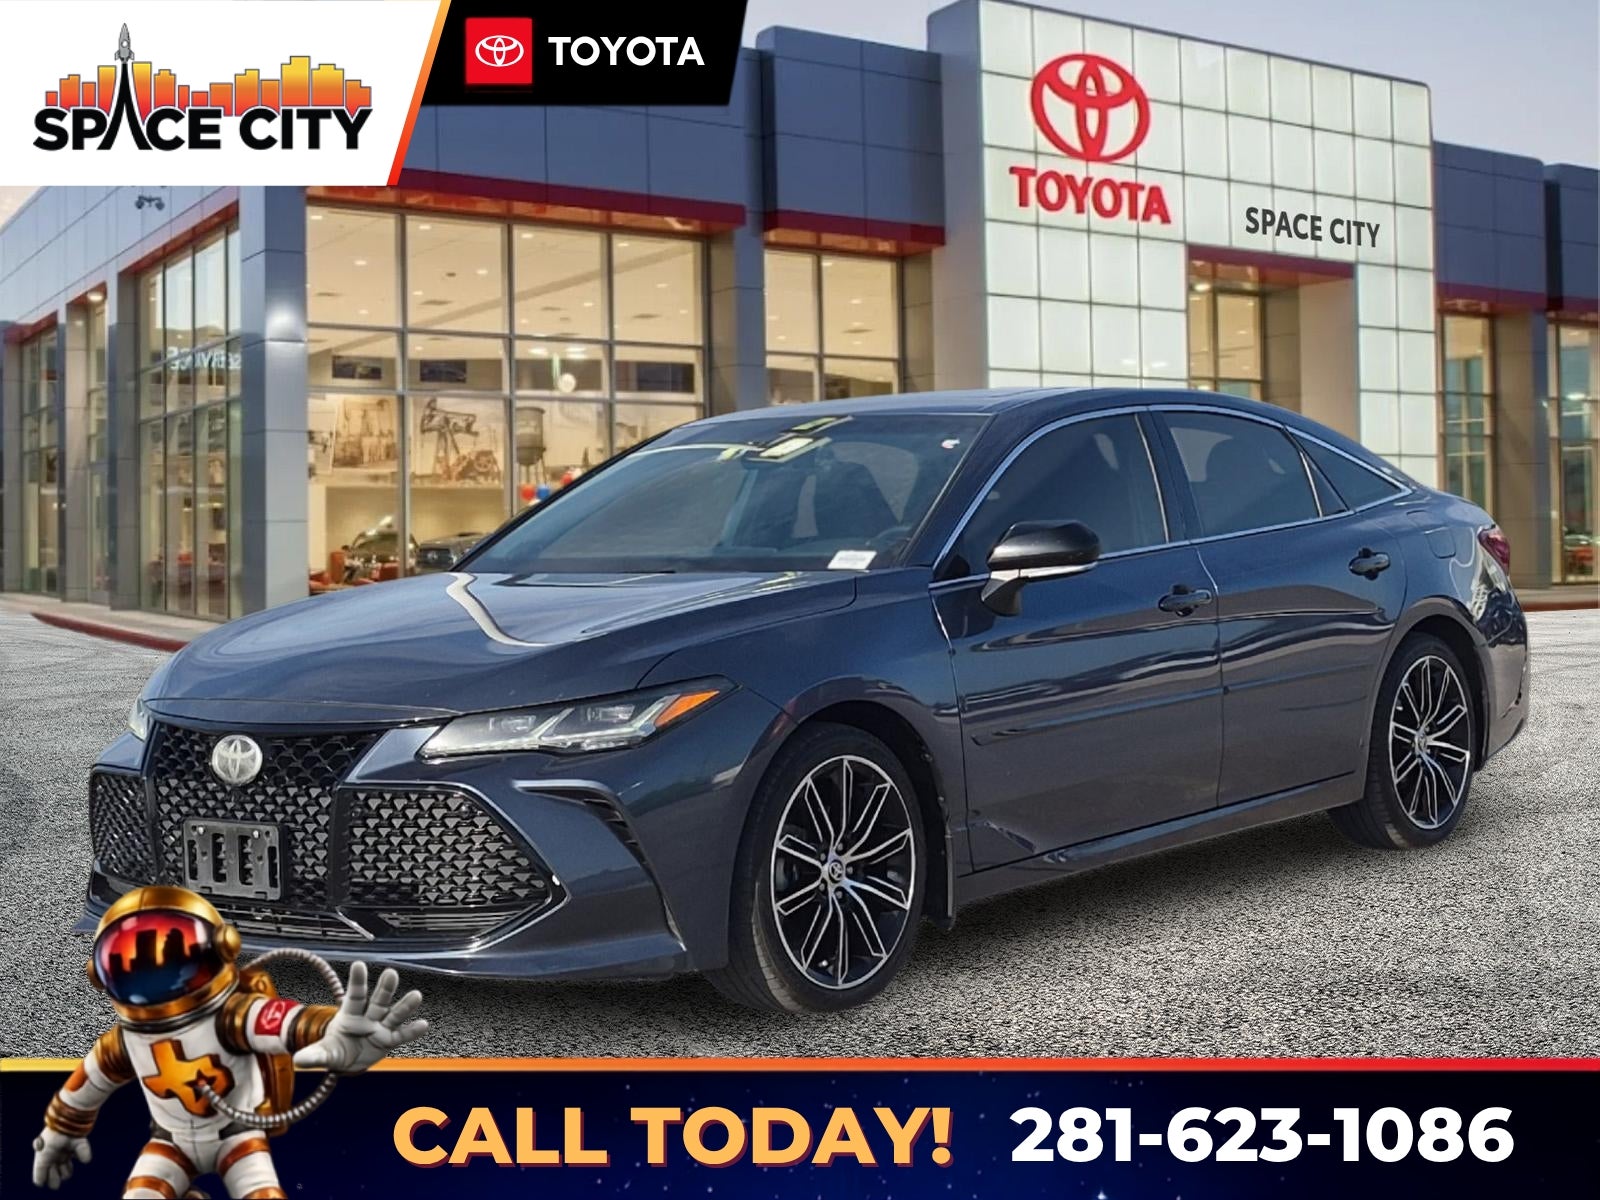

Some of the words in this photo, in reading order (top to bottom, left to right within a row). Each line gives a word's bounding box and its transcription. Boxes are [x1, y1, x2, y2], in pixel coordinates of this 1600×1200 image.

[1010, 166, 1171, 224] TOYOTA
[1244, 206, 1323, 242] SPACE
[1329, 218, 1381, 249] CITY
